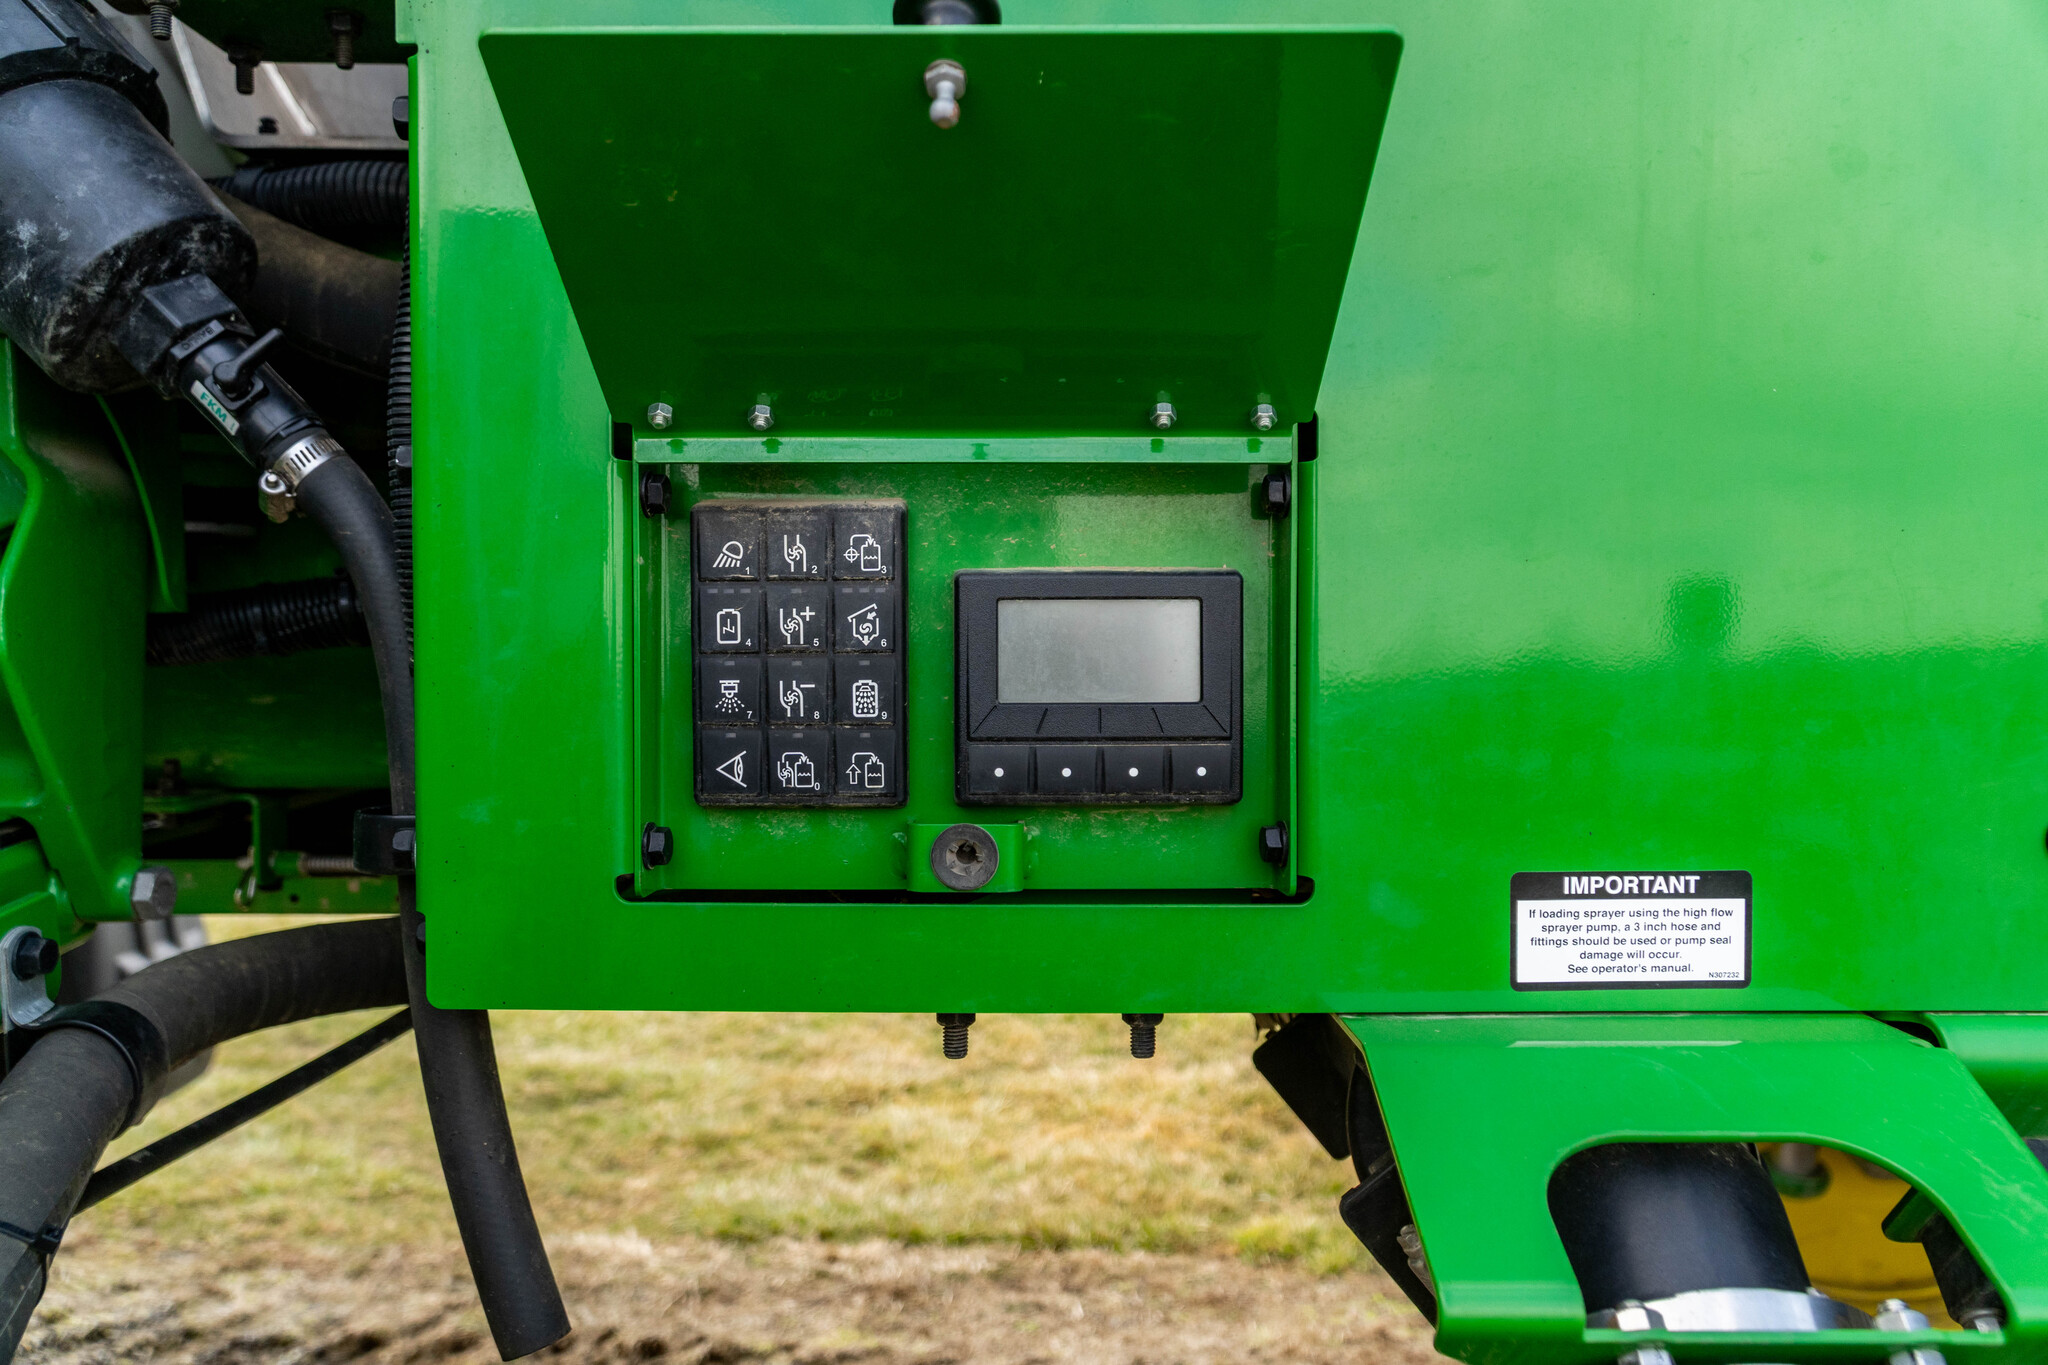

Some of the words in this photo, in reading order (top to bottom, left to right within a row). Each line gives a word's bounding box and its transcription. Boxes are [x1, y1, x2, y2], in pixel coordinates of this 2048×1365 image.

[200, 392, 227, 422] FKM
[745, 566, 750, 575] 1
[811, 565, 818, 574] 2
[881, 565, 887, 574] 3
[745, 638, 752, 647] 4
[813, 638, 820, 647] 5
[880, 638, 887, 647] 6
[746, 710, 753, 719] 7
[813, 710, 820, 720] 8
[881, 711, 888, 720] 9
[814, 782, 821, 791] 0
[1563, 875, 1700, 894] IMPORTANT
[1528, 909, 1536, 918] If
[1539, 909, 1580, 920] loading
[1583, 911, 1626, 919] sprayer
[1628, 908, 1660, 919] using
[1662, 908, 1681, 917] the
[1683, 908, 1708, 919] high
[1710, 908, 1734, 917] flow
[1541, 925, 1584, 934] sprayer
[1624, 923, 1631, 932] a
[1633, 922, 1641, 931] 3
[1643, 922, 1667, 931] inch
[1670, 923, 1698, 931] hose
[1700, 922, 1721, 930] and
[1530, 937, 1569, 948] fittings
[1571, 937, 1610, 945] should
[1613, 937, 1627, 945] be
[1629, 937, 1657, 945] used
[1659, 937, 1672, 946] or
[1674, 938, 1707, 946] pump
[1709, 936, 1732, 945] seal
[1579, 951, 1624, 961] damage
[1626, 950, 1645, 959] will
[1648, 951, 1682, 959] occur.
[1567, 964, 1589, 973] See
[1591, 964, 1648, 975] operator's
[1650, 964, 1694, 973] manual.
